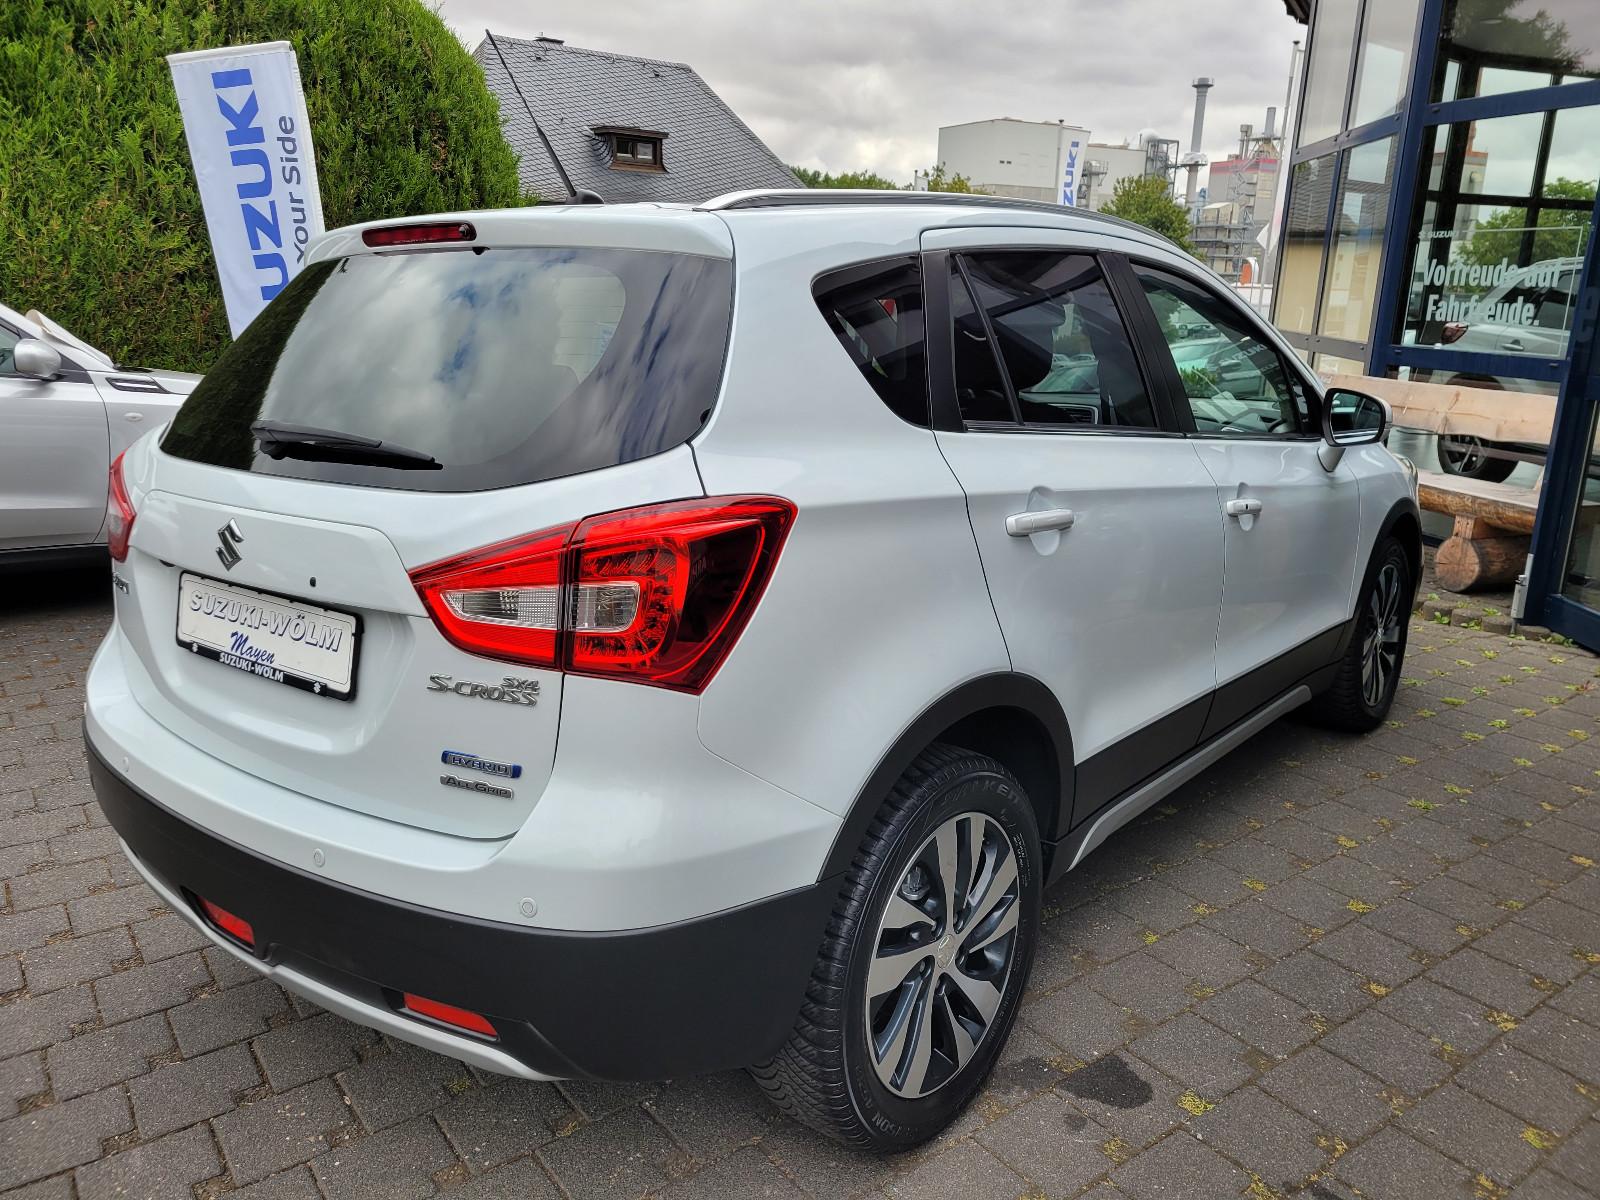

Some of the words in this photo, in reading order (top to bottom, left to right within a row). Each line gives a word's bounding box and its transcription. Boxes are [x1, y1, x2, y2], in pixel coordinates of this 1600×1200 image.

[276, 115, 301, 186] Side
[1422, 256, 1519, 288] Vorfreude
[1523, 257, 1566, 288] auf
[1425, 294, 1540, 326] Fahrfeude.
[190, 589, 344, 653] SUZUKI-WÖLM
[230, 630, 276, 664] Mayen
[426, 672, 540, 707] S-CROSS
[501, 675, 541, 692] SX4
[451, 755, 510, 776] HYBRID
